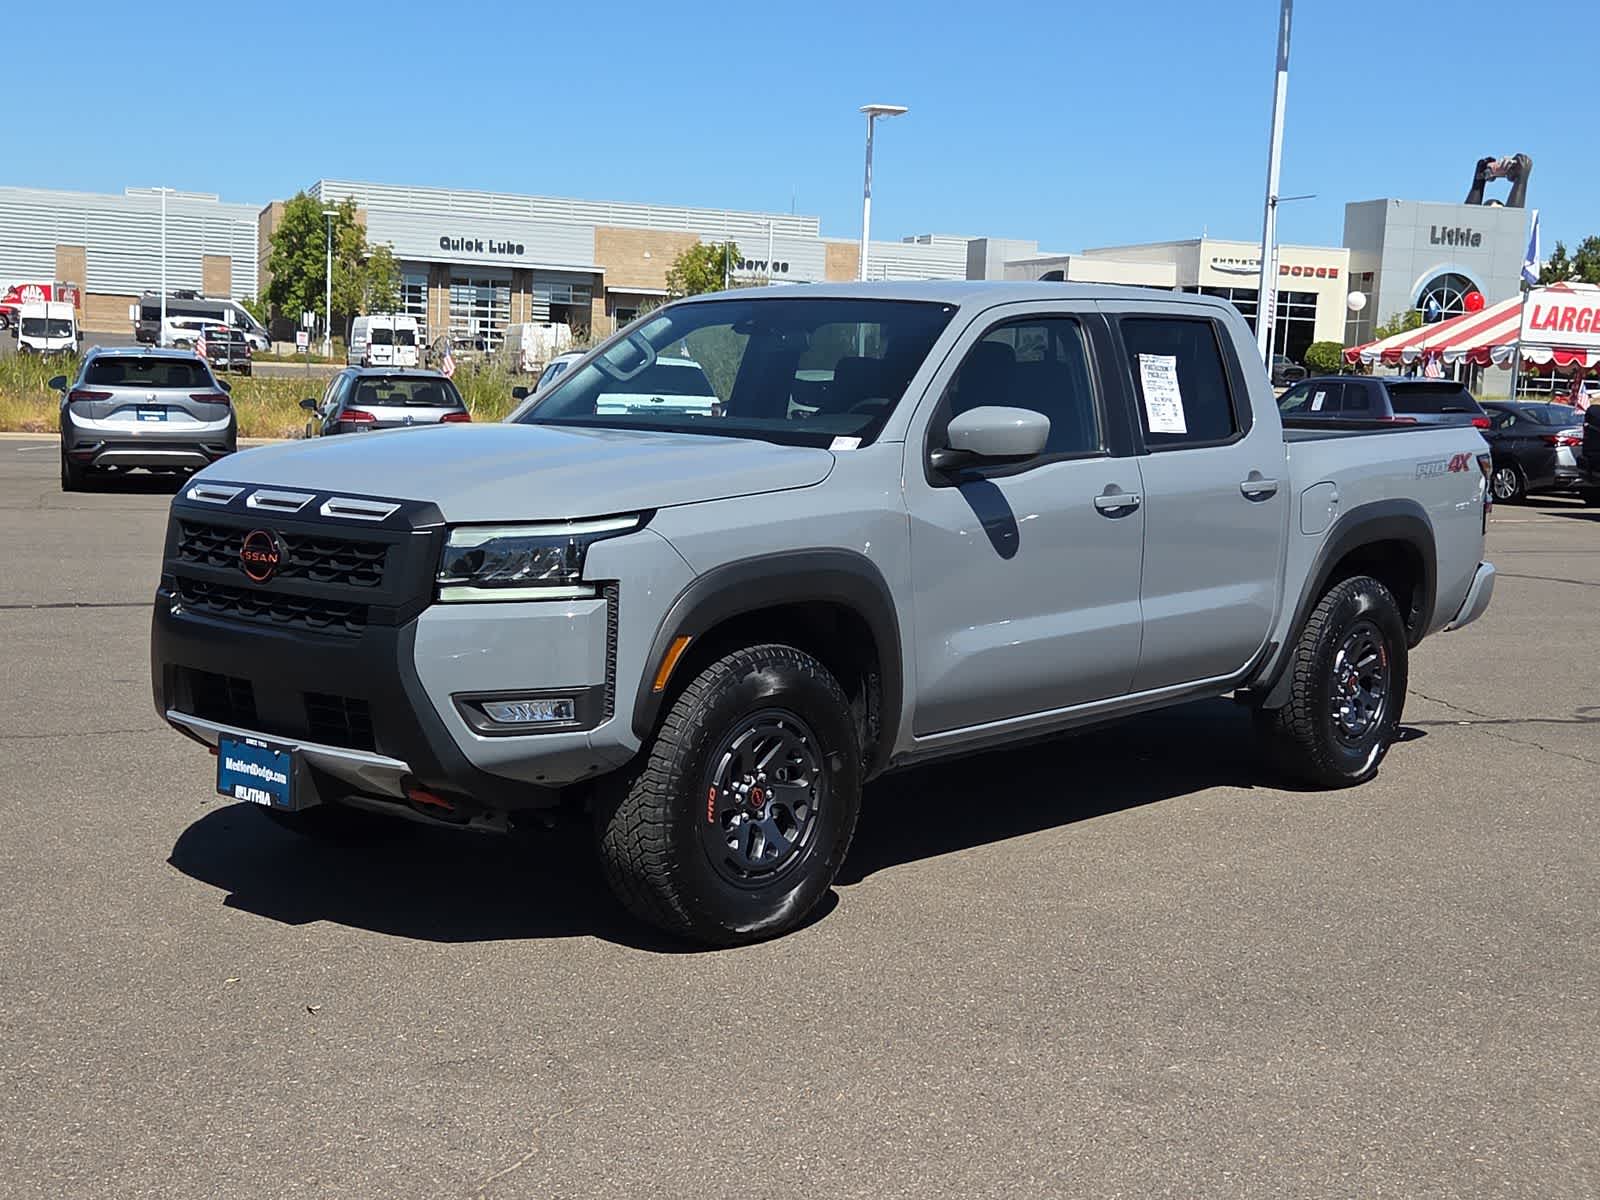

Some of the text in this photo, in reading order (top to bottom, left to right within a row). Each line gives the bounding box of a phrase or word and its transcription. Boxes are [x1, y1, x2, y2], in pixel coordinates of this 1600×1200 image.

[1430, 225, 1481, 248] Lithia
[439, 236, 525, 256] Quick Lube
[736, 257, 789, 273] Servce
[1212, 256, 1261, 265] CHRYSLE
[1279, 264, 1338, 279] DODGE
